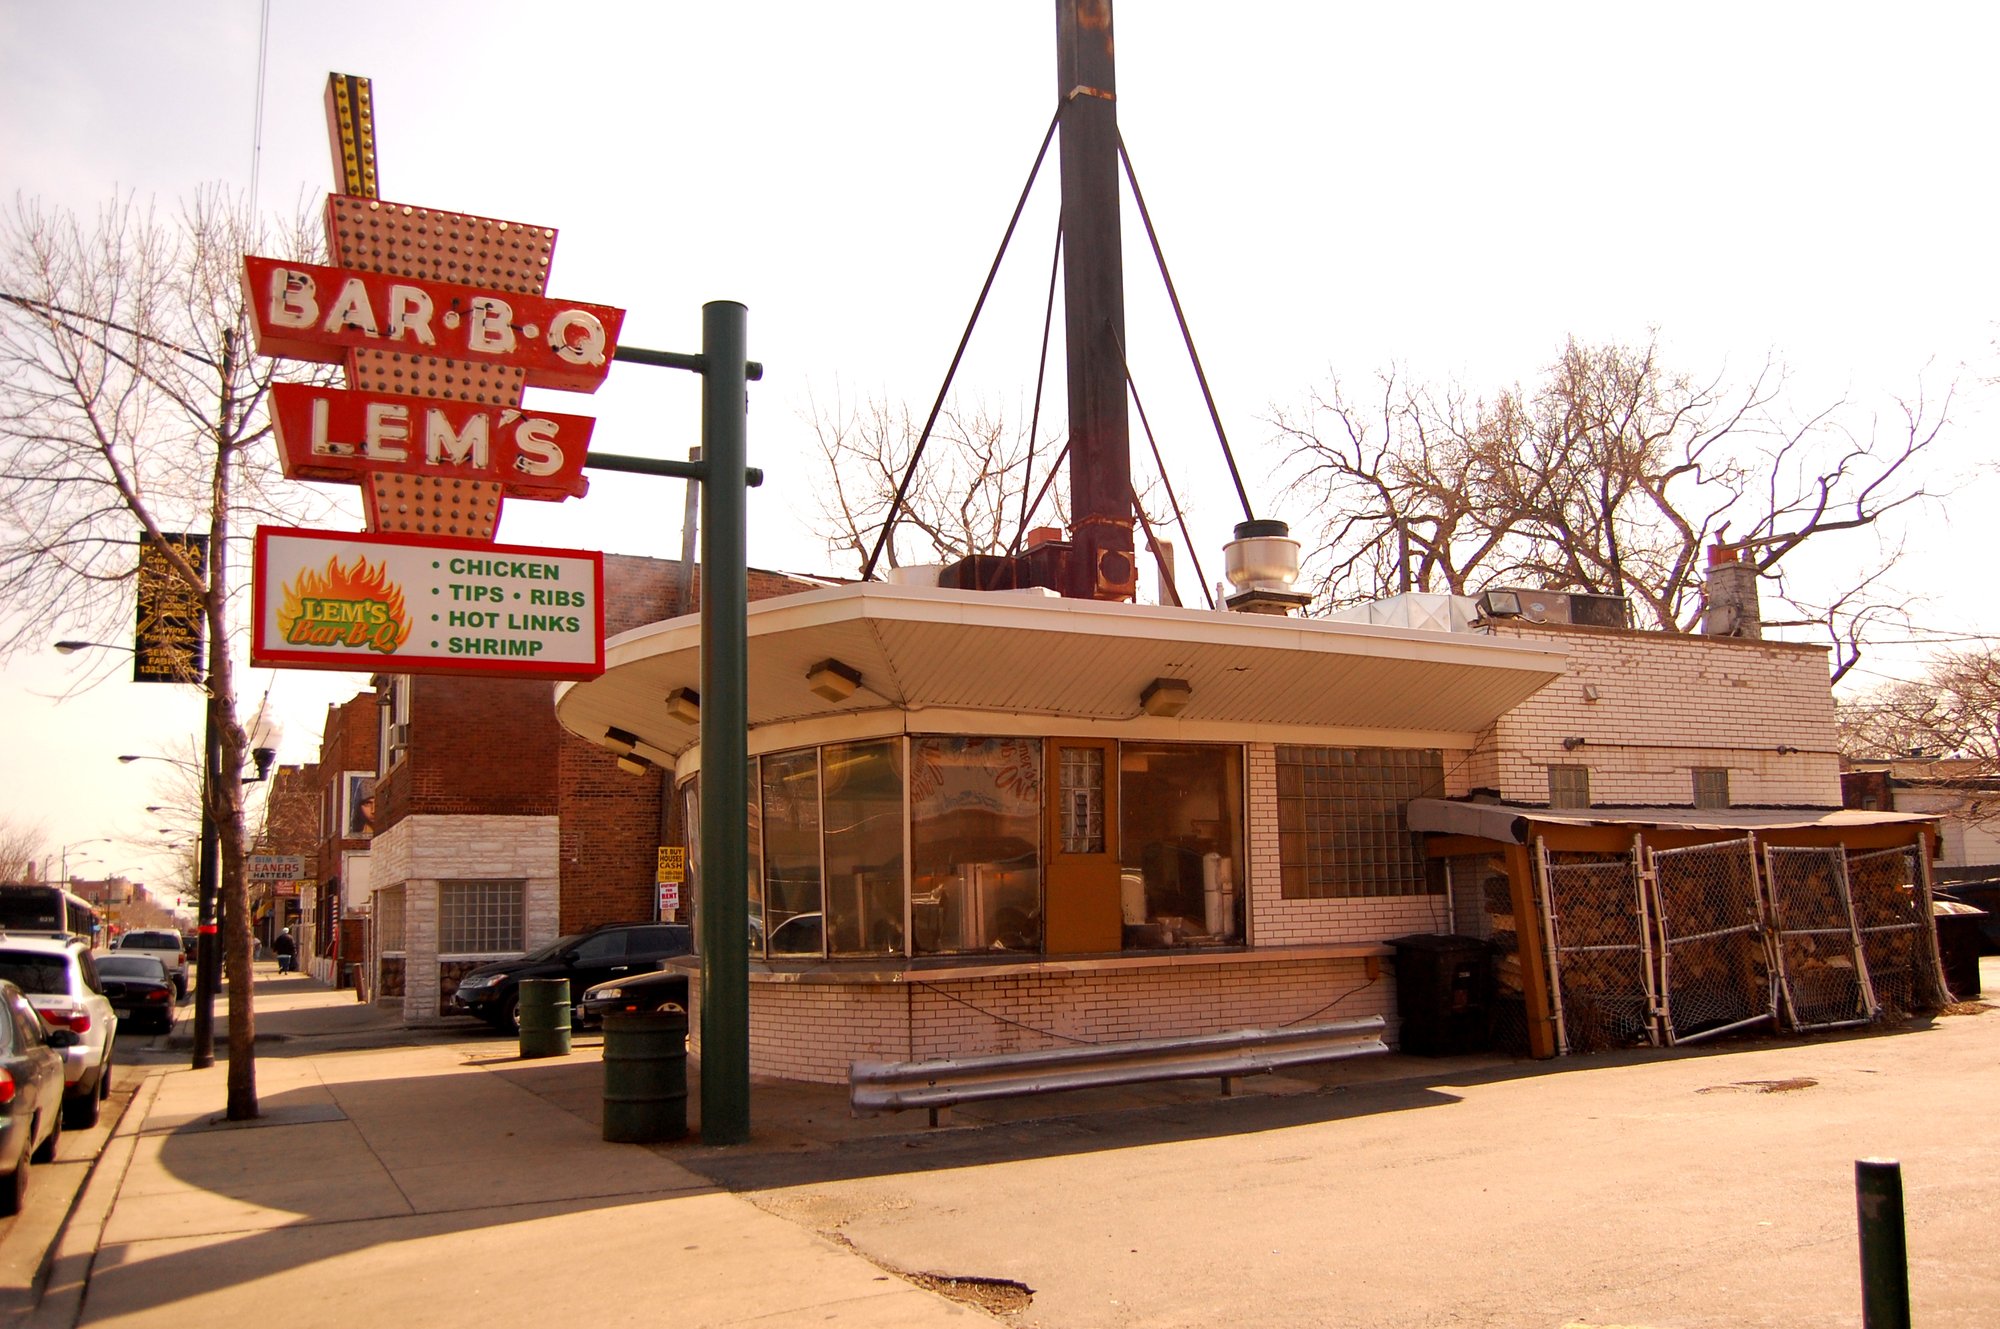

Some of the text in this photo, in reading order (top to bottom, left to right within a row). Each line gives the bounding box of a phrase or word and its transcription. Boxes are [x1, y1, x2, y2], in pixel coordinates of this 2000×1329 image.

[311, 398, 565, 476] LEM'S
[449, 558, 560, 580] CHICKEN
[448, 584, 586, 607] TIPS RIBS
[305, 600, 387, 625] LEM'S
[449, 610, 581, 633] HOT LINKS
[448, 637, 543, 656] SHRIMP
[248, 863, 299, 872] LEANERS
